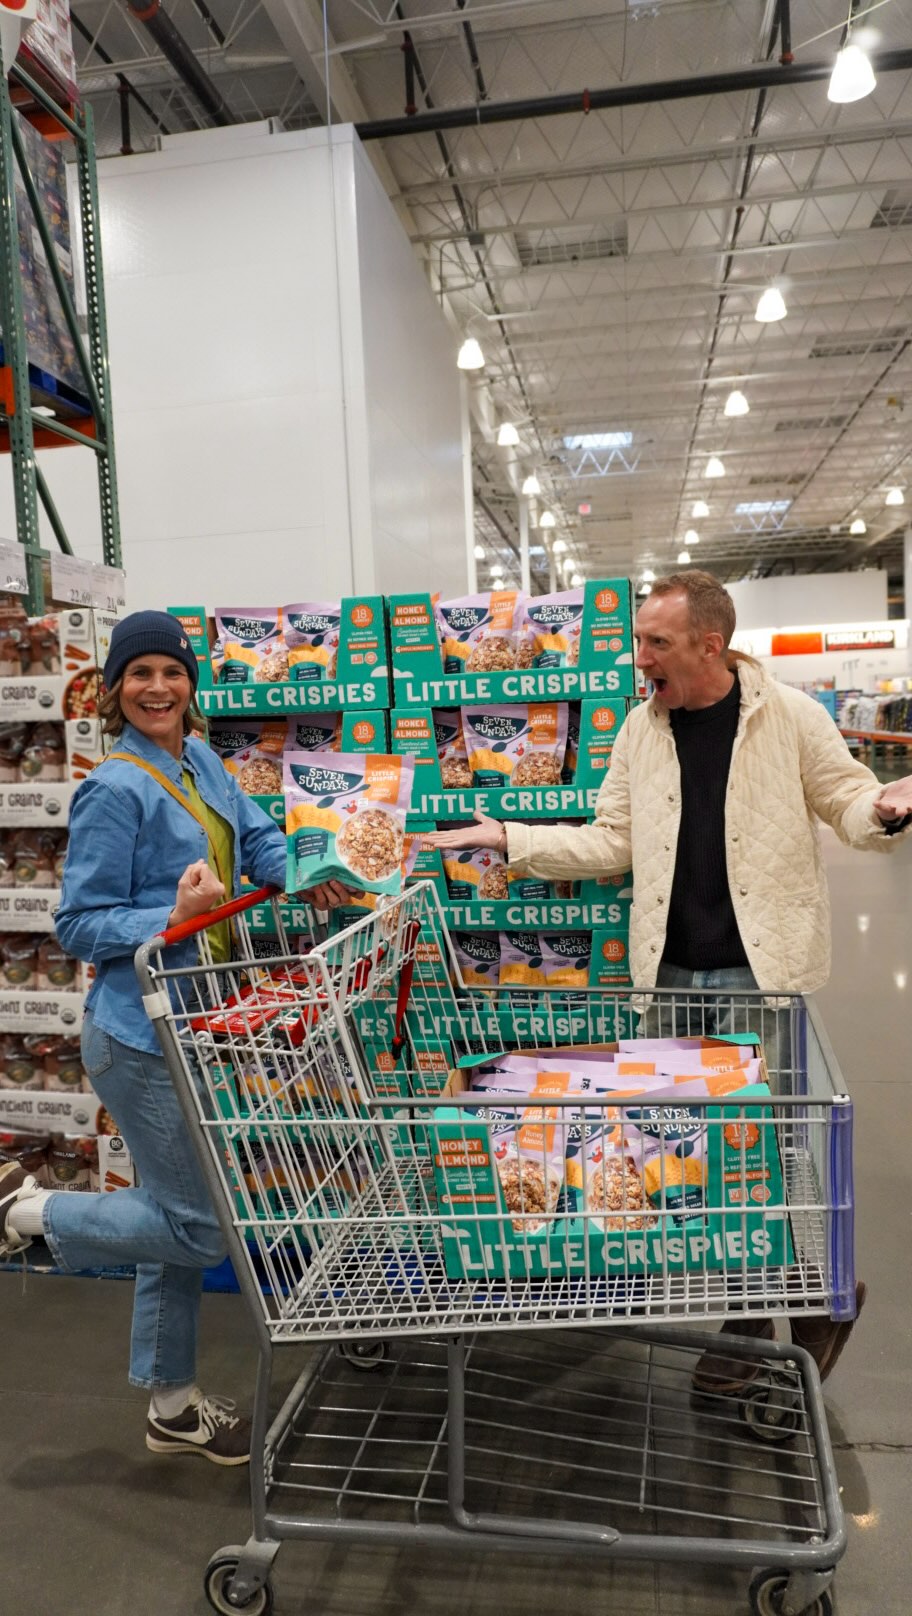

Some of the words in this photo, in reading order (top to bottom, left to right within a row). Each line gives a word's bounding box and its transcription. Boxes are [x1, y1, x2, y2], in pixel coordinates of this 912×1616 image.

[601, 594, 612, 604] 18
[356, 609, 367, 618] 18
[397, 606, 424, 614] HONEY
[541, 606, 570, 614] SEVEN
[179, 617, 198, 626] ONEY
[301, 614, 328, 622] SEVEN
[394, 616, 428, 626] ALMOND
[448, 614, 478, 627] SUNDAYS
[533, 612, 574, 622] SUNDAYS
[235, 618, 262, 628] SEVEN
[293, 620, 332, 630] SUNDAYS
[228, 625, 266, 638] SUNDAYS
[406, 678, 492, 702] LITTLE
[502, 670, 620, 696] CRISPIES
[195, 688, 256, 710] TTLE
[266, 683, 376, 707] CRISPIES
[482, 716, 512, 726] SEVEN
[598, 712, 608, 722] 18
[398, 720, 425, 728] HONEY
[475, 722, 517, 736] SUNDAYS
[359, 726, 368, 735] 18
[396, 730, 428, 738] ALMOND
[309, 768, 344, 781] SEVEN
[299, 775, 349, 792] SUNDAYS
[408, 793, 490, 814] LITTLE
[501, 788, 598, 812] CRISPIE
[506, 904, 622, 925] CRISPIES
[470, 937, 497, 949] SEVEN
[512, 938, 541, 953] SUNDA
[608, 943, 619, 953] 18
[461, 941, 500, 960] SUNDAYS
[419, 1016, 500, 1035] LITTLE
[512, 1016, 626, 1036] CRISPIES
[381, 1056, 390, 1064] 18
[441, 1141, 479, 1152] HONEY
[462, 1242, 585, 1270] LITTLE
[602, 1228, 773, 1266] CRISPIES
